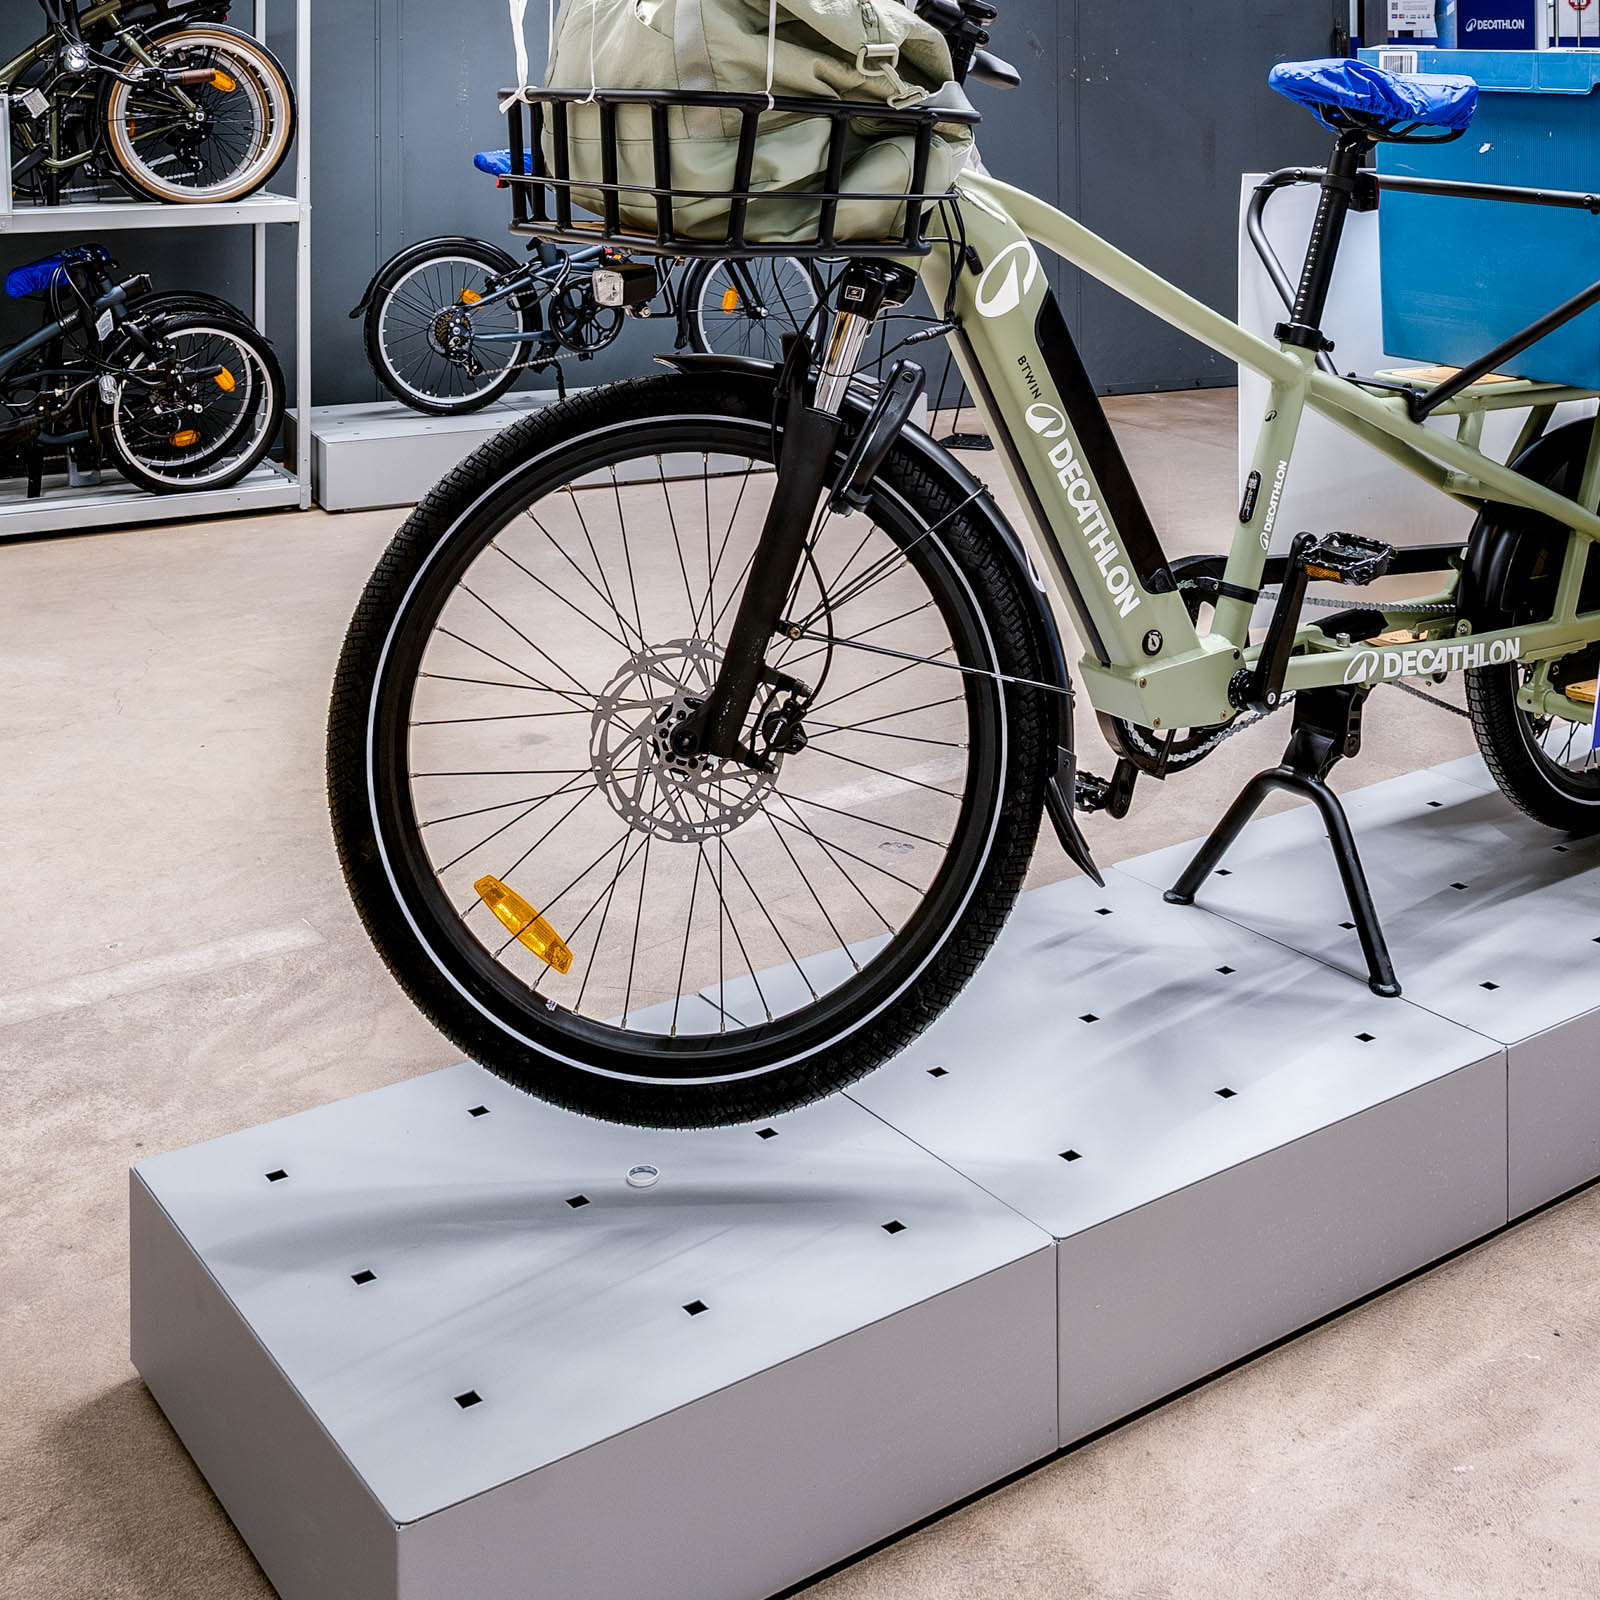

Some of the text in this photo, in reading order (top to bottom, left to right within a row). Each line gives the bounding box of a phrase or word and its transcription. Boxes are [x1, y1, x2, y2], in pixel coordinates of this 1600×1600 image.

[1477, 18, 1525, 31] DECATHLON
[1264, 460, 1288, 533] DECATHLON
[1048, 437, 1141, 619] DECATHLON
[1382, 636, 1521, 680] DECATHLON
